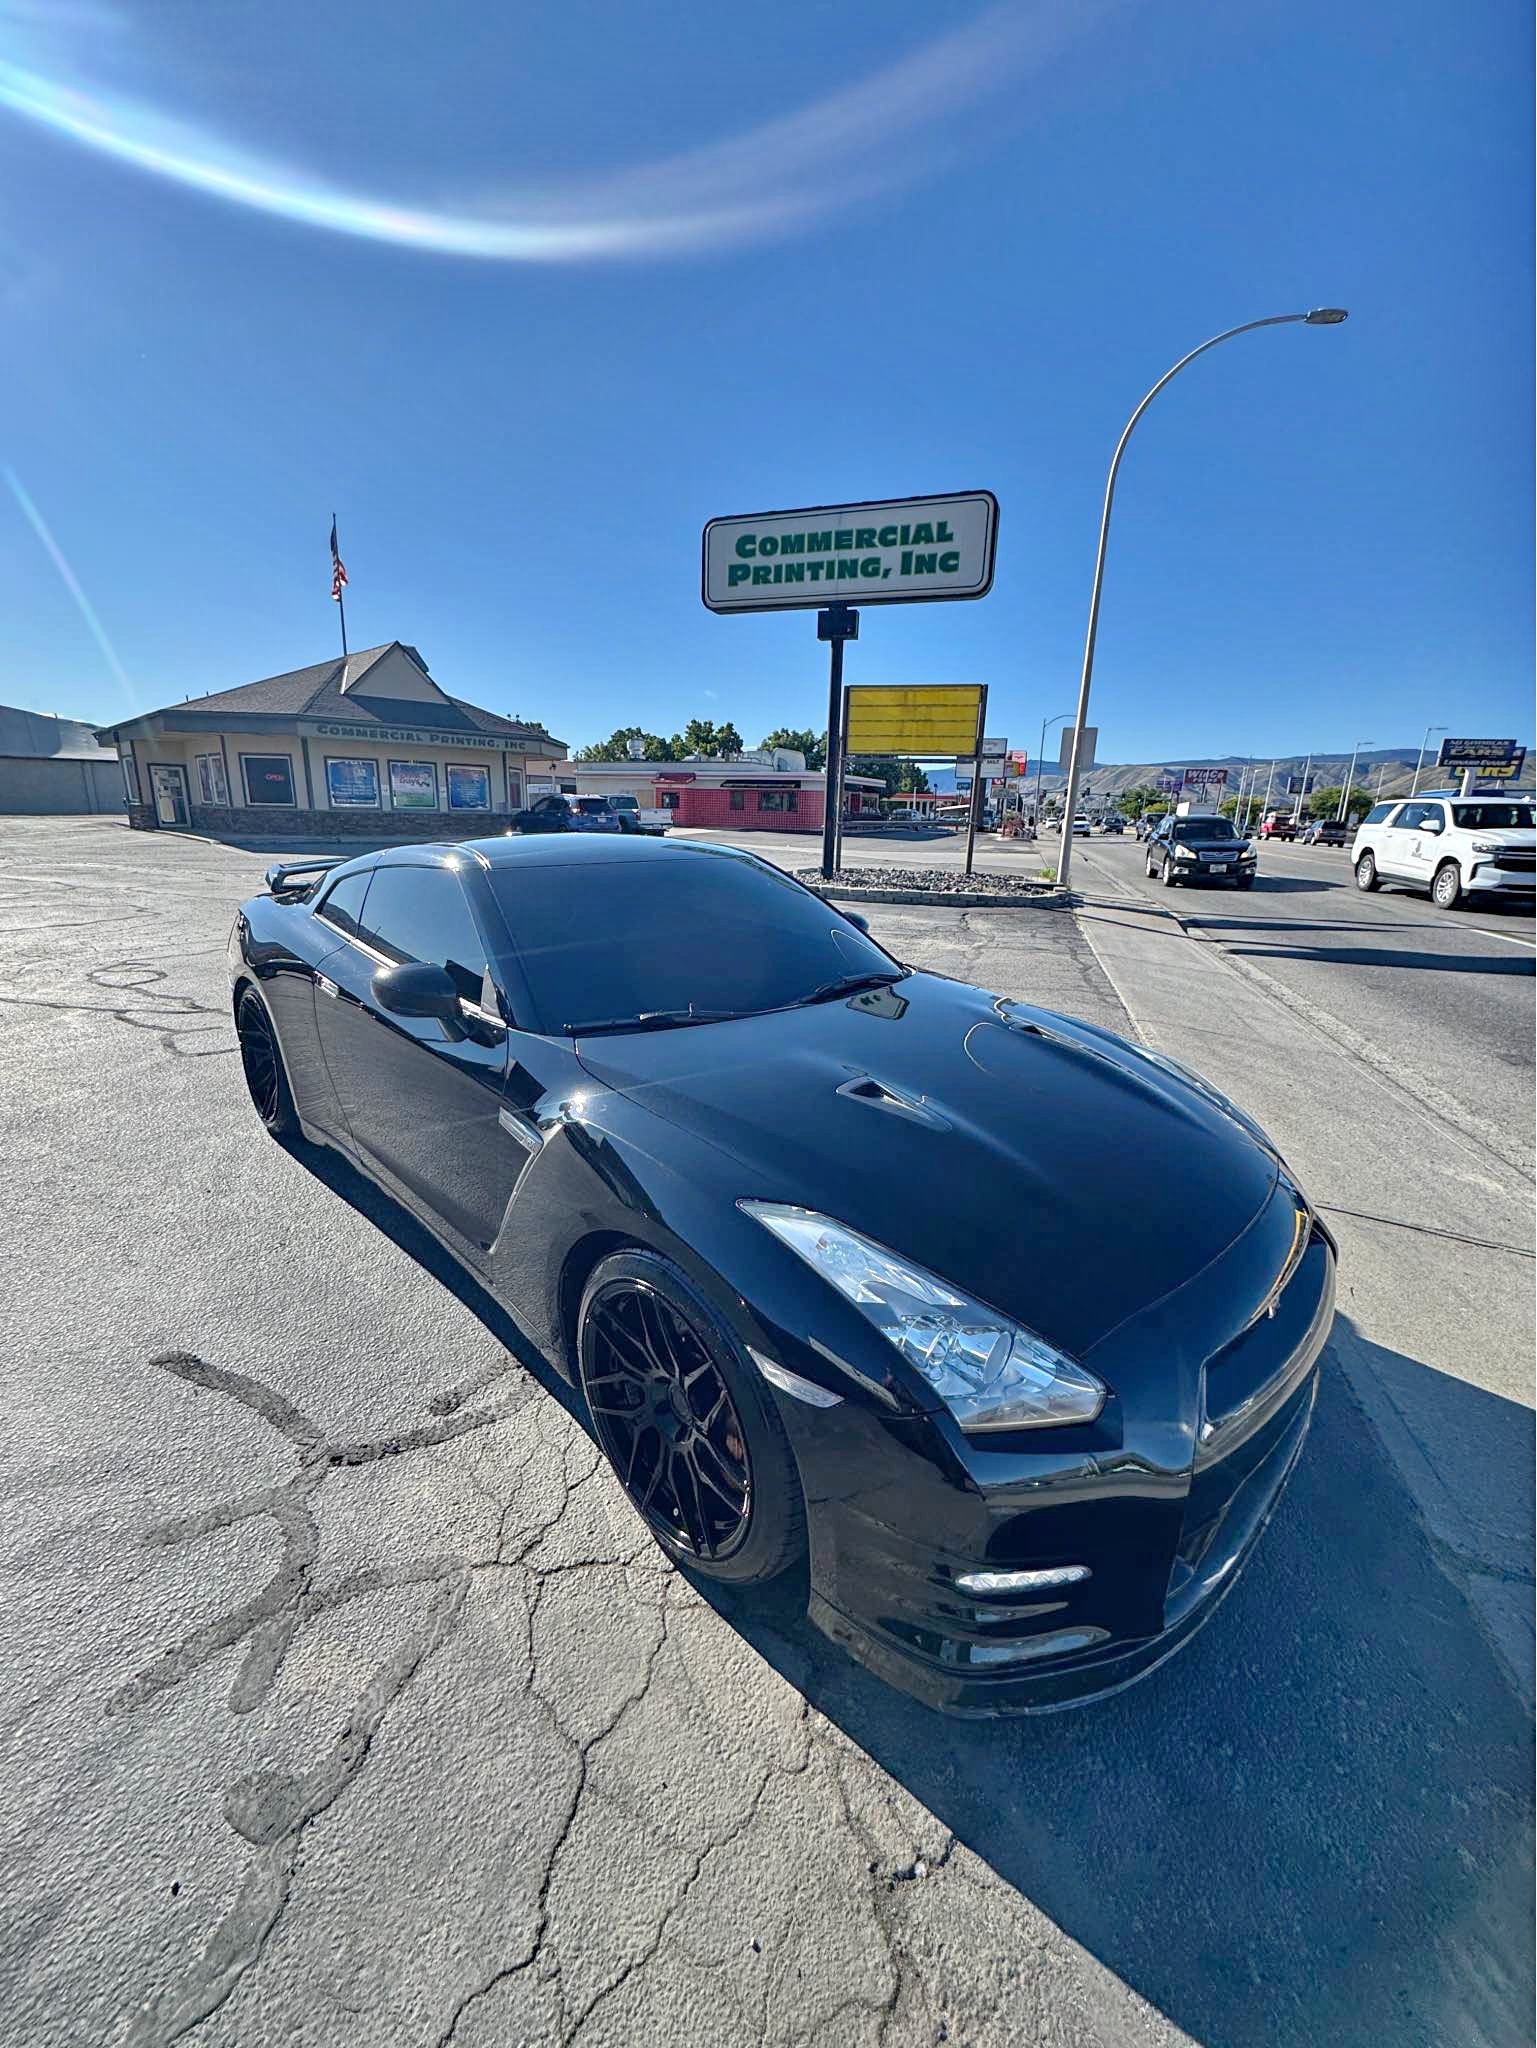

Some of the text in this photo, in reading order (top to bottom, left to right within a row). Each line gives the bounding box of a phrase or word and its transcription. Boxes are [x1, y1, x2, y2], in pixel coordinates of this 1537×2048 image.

[736, 521, 954, 559] COMMERCIAL
[727, 550, 961, 588] PRINTING, INC
[317, 725, 424, 742] COMMERCIAL
[505, 740, 527, 750] INC
